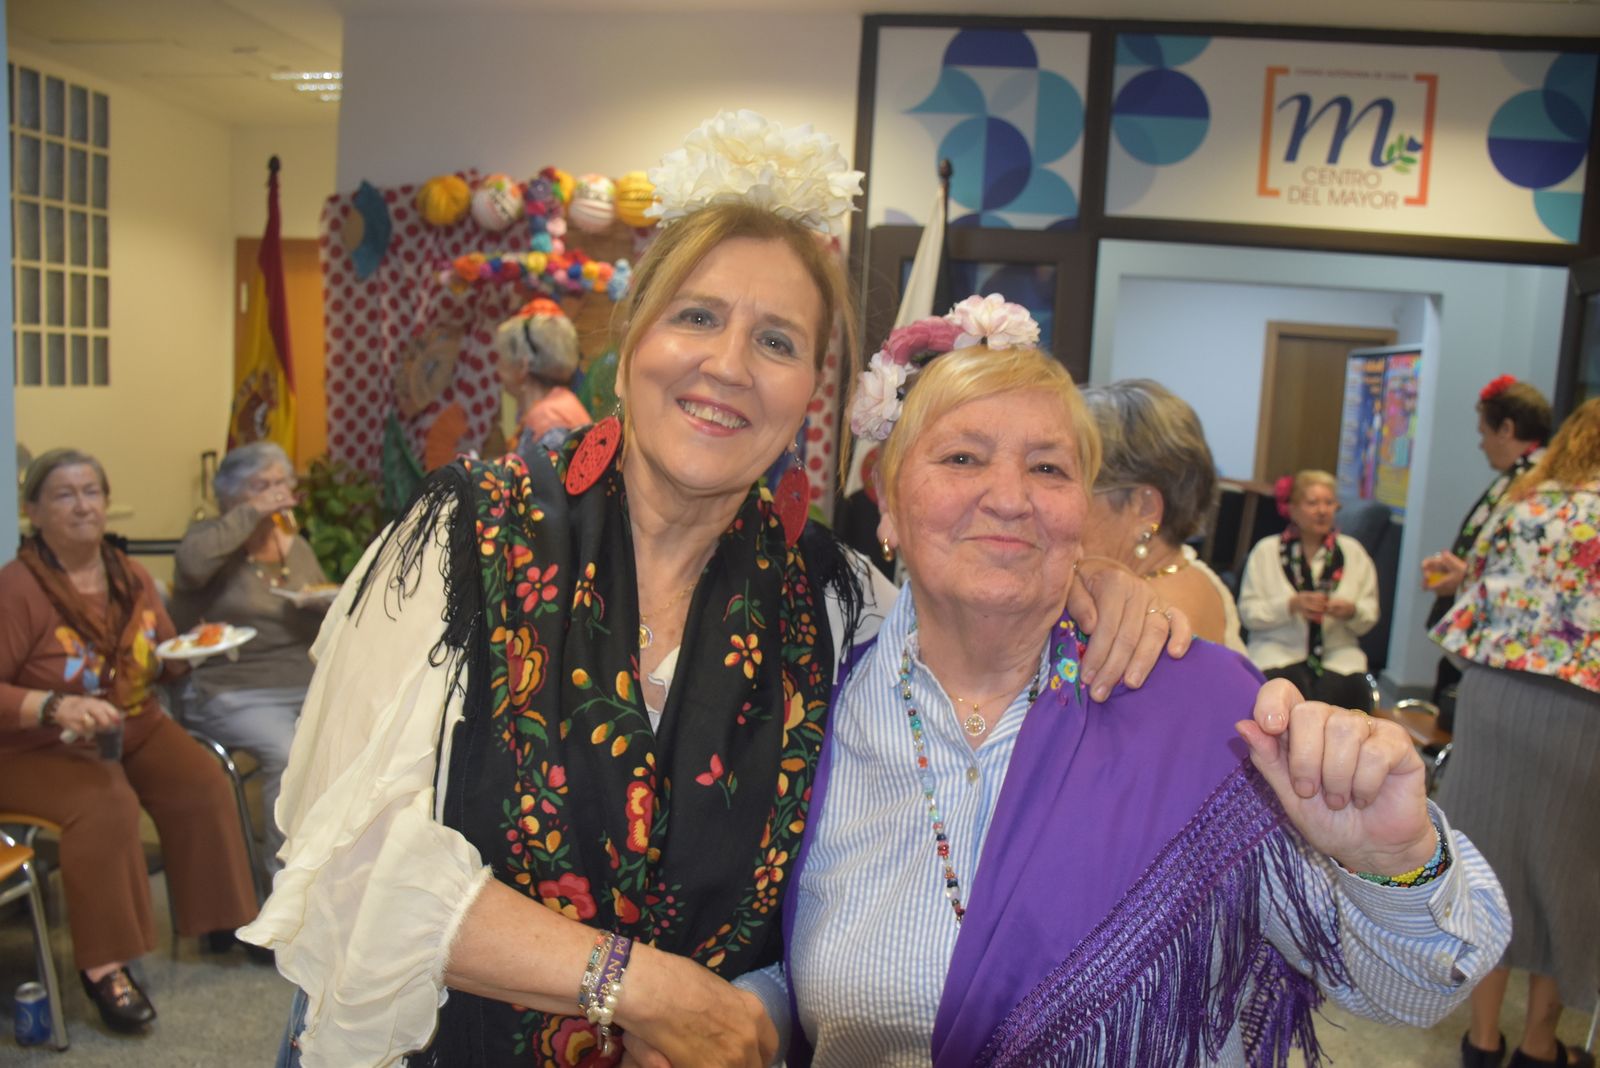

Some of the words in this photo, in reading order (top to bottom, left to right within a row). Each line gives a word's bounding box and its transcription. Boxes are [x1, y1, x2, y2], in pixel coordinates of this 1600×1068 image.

[1301, 166, 1382, 189] CENTRO
[1287, 185, 1321, 206] DEL
[1327, 189, 1399, 210] MAYOR
